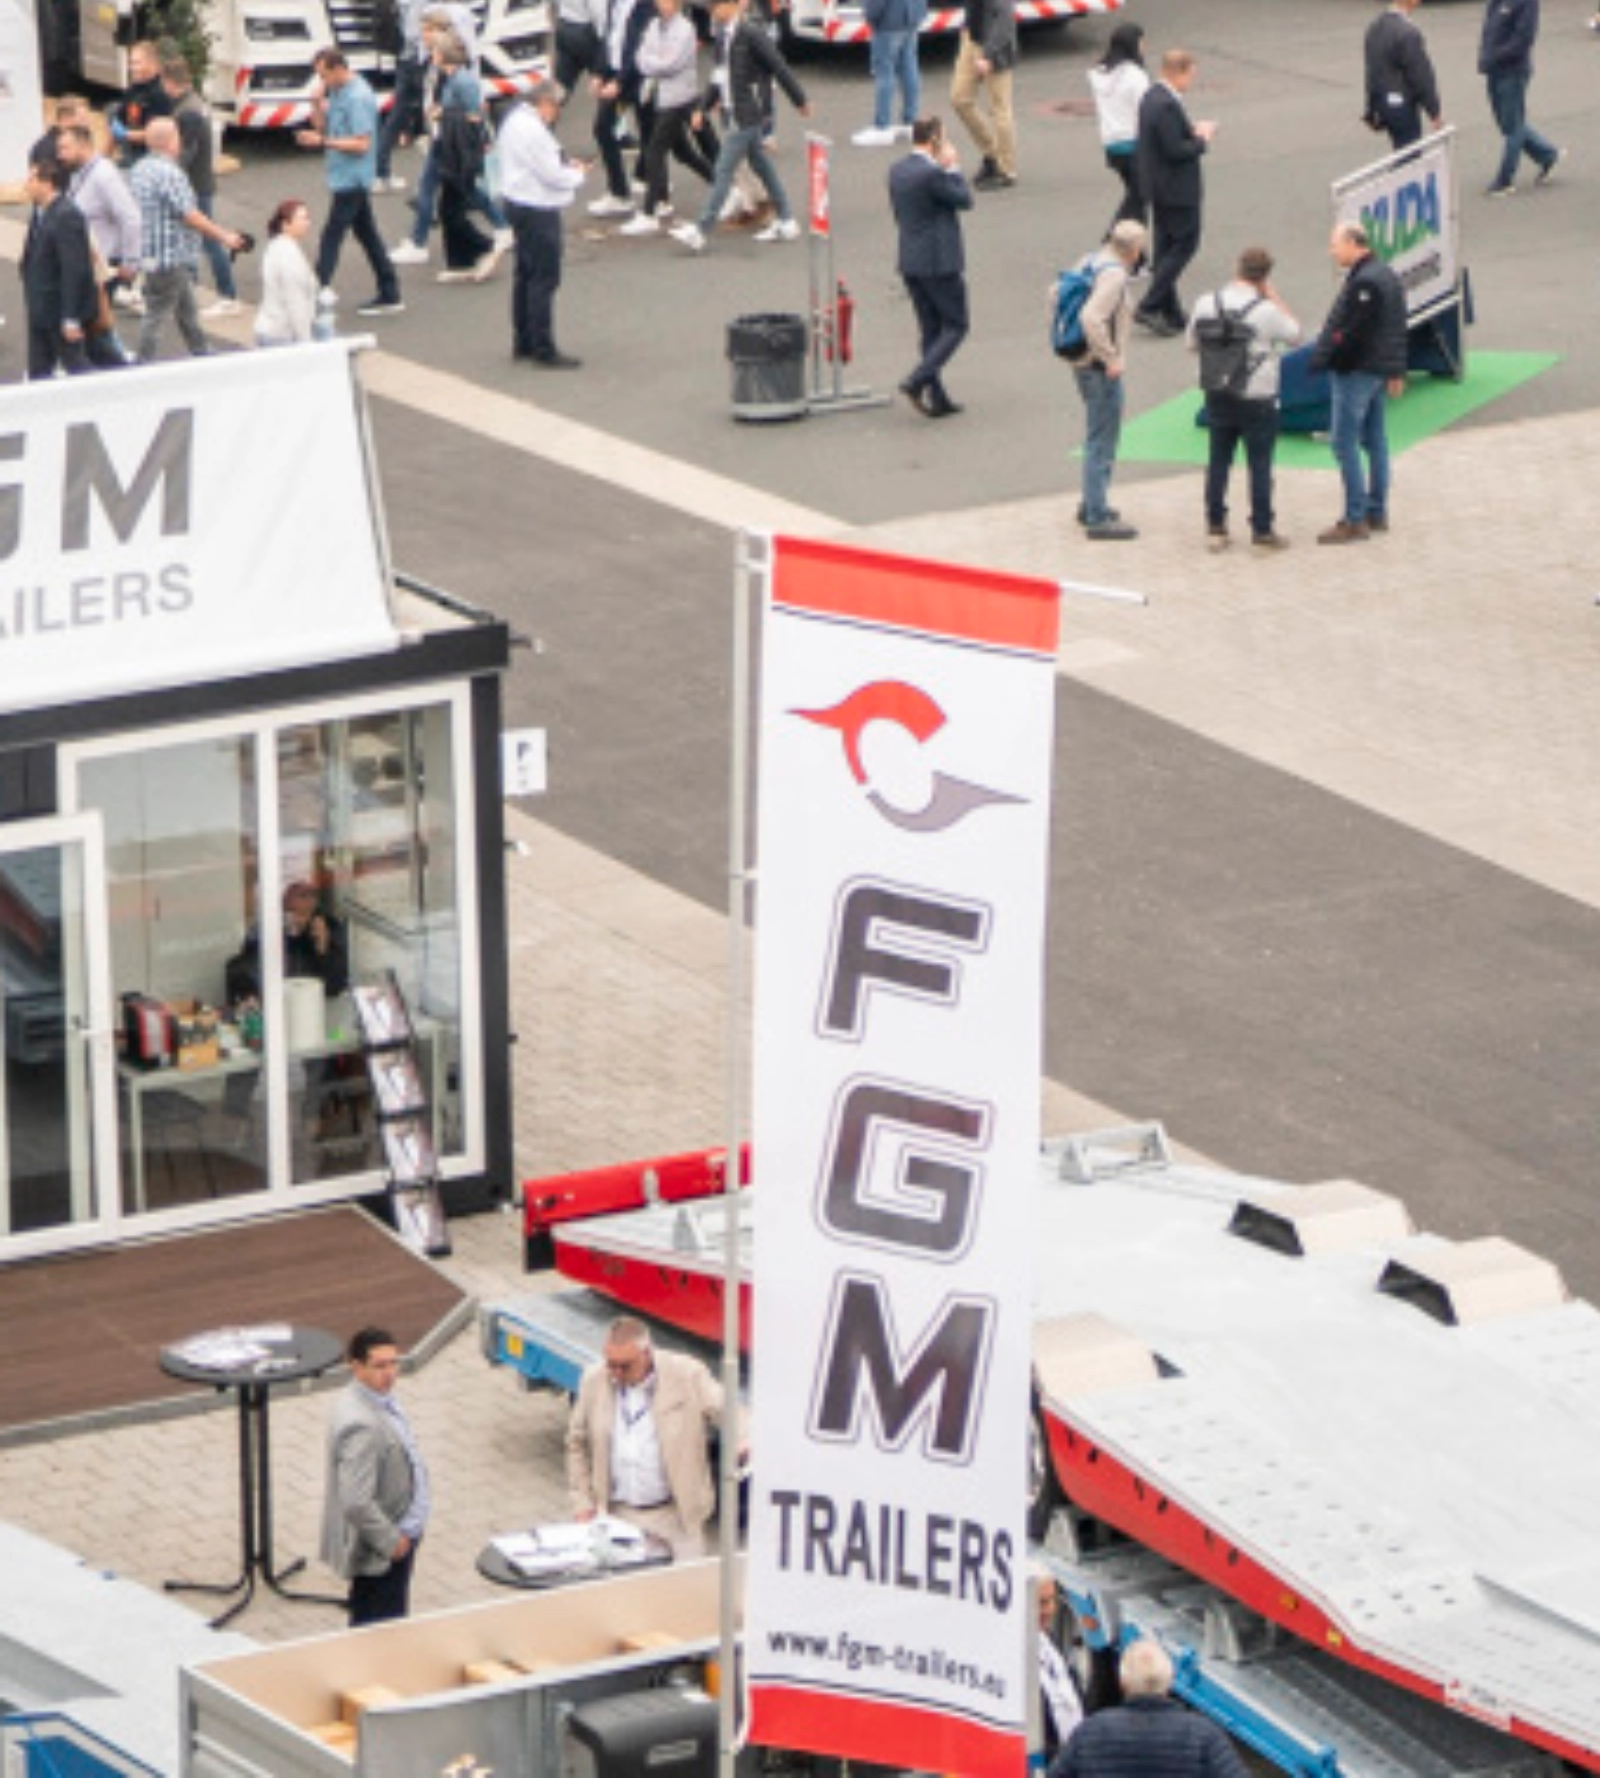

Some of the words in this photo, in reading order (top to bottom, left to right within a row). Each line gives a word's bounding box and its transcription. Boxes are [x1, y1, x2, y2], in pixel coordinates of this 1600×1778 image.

[0, 561, 194, 641] ILERS
[814, 873, 995, 1468] FGM
[768, 1490, 1014, 1614] TRAILERS
[767, 1630, 1007, 1700] www.fgm-trailers.eu
